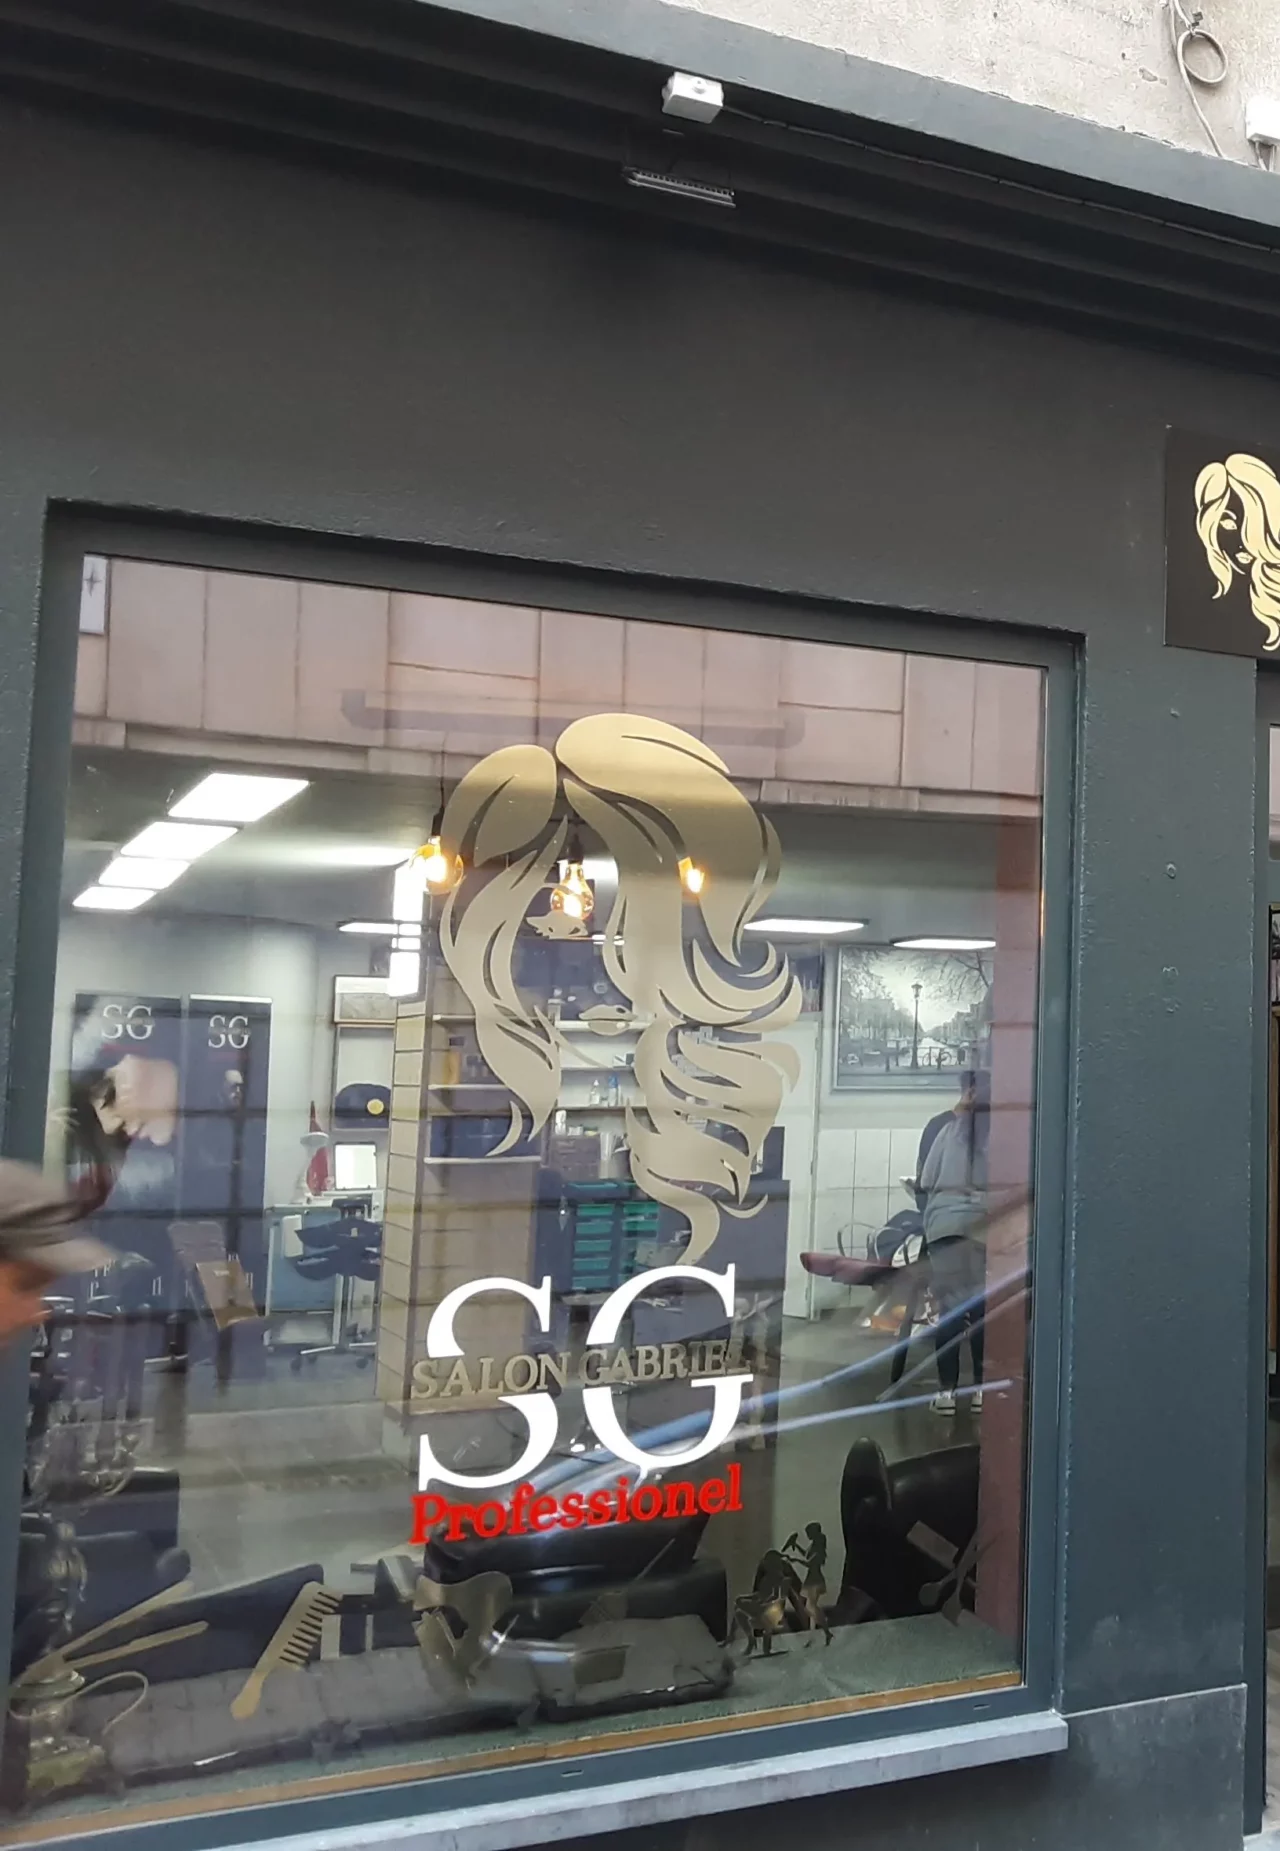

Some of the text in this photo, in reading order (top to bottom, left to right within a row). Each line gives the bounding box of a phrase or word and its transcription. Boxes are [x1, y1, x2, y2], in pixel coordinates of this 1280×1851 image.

[411, 1352, 571, 1400] SALON
[418, 1263, 753, 1491] SG
[409, 1463, 742, 1545] Professionel
